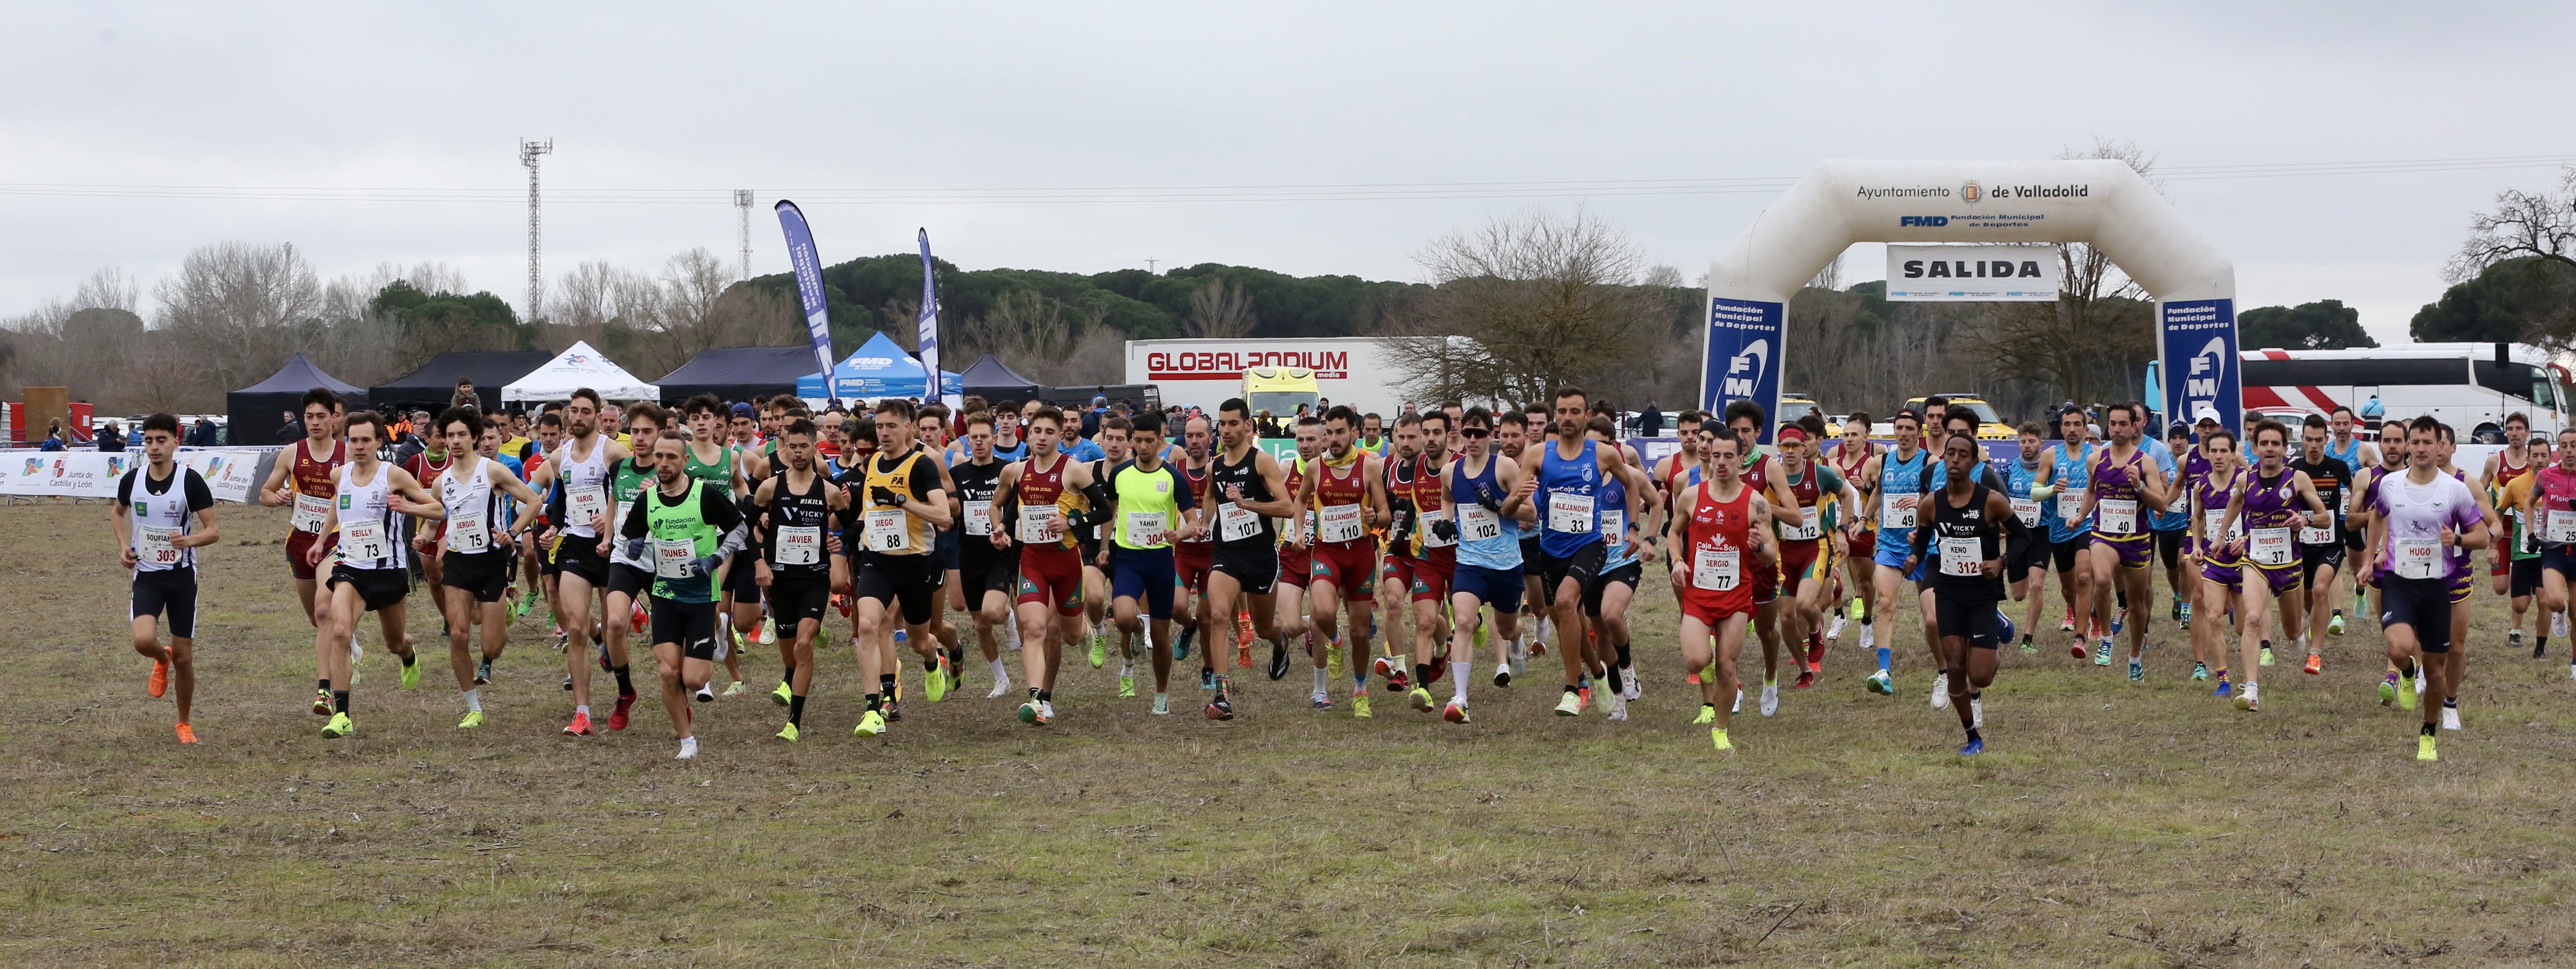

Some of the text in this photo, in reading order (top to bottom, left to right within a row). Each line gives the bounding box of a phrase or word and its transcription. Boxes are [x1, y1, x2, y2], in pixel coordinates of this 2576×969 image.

[1857, 185, 2088, 200] Ayuntamiento de Valladolid
[1901, 216, 1948, 227] FMD
[1904, 261, 2041, 278] SALIDA
[1716, 304, 1763, 314] Fundación
[2167, 306, 2215, 314] Fundación
[1715, 312, 1763, 322] Municipal
[2168, 314, 2216, 323] Municipal
[1727, 322, 1775, 331] Deportes
[2181, 322, 2229, 330] Deportes
[849, 357, 893, 366] FMD
[1148, 352, 1347, 371] GLOBALPODIUM
[228, 474, 241, 483] Junta
[891, 476, 904, 485] PA
[234, 483, 246, 491] León
[576, 494, 593, 503] MARIO
[1227, 508, 1247, 518] DANIEL
[1555, 502, 1589, 513] ALEJANDRO
[2013, 504, 2036, 513] ALBERTO
[800, 510, 824, 518] VICKY
[1324, 512, 1357, 521] ALEJANDRO
[456, 520, 475, 529] SERGIO
[665, 516, 696, 524] Fundación
[875, 518, 893, 527] DIEGO
[1902, 515, 1914, 527] 49
[2024, 518, 2034, 527] 48
[1238, 521, 1256, 537] 107
[1476, 523, 1497, 538] 102
[1570, 520, 1584, 532] 33
[2118, 521, 2129, 532] 40
[351, 528, 372, 537] REILLY
[1038, 528, 1058, 542] 314
[1340, 525, 1359, 539] 110
[1798, 526, 1816, 538] 112
[2314, 531, 2330, 542] 313
[469, 534, 482, 547] 75
[788, 535, 812, 543] JAVIER
[887, 534, 900, 548] 88
[1146, 532, 1163, 546] 304
[1603, 533, 1617, 544] 09
[365, 544, 379, 558] 73
[660, 547, 688, 557] YOUNES
[1697, 542, 1712, 551] Caja
[2410, 547, 2431, 556] HUGO
[157, 550, 176, 562] 303
[803, 550, 810, 563] 2
[2272, 551, 2284, 563] 37
[679, 564, 687, 577] 5
[1957, 561, 1978, 574] 312
[2424, 563, 2430, 576] 7
[1717, 575, 1731, 589] 77
